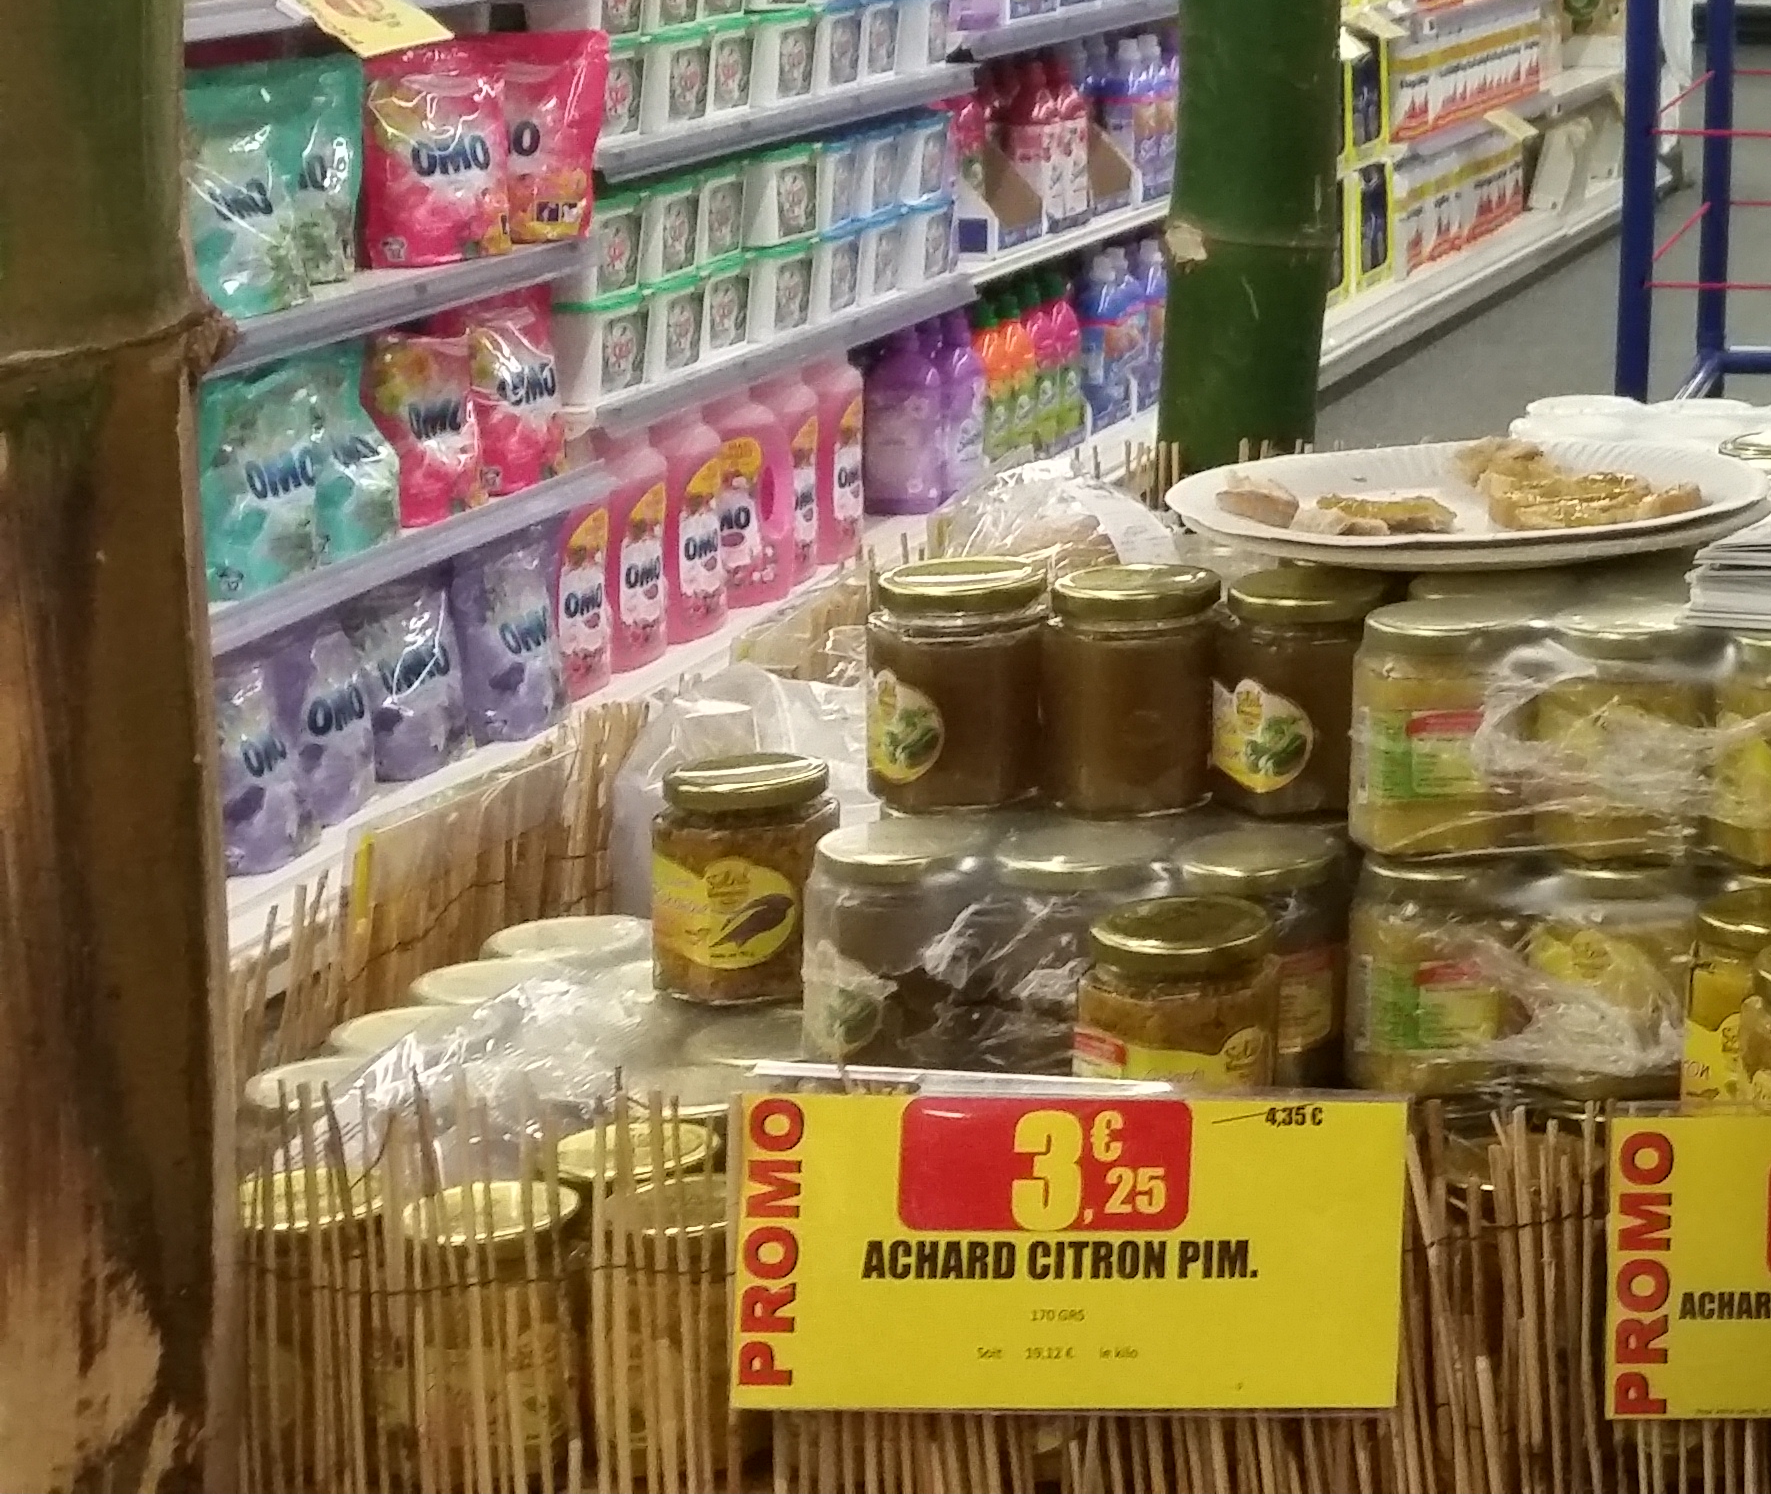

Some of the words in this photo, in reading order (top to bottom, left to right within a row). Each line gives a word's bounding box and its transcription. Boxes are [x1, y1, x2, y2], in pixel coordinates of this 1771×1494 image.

[411, 133, 491, 177] OMO
[307, 683, 365, 736] OMO
[736, 1097, 806, 1388] PROMO
[860, 1239, 1018, 1281] ACHARD
[1026, 1239, 1169, 1281] CITRON
[1175, 1239, 1259, 1280] PIM.
[1614, 1130, 1675, 1415] PROMO
